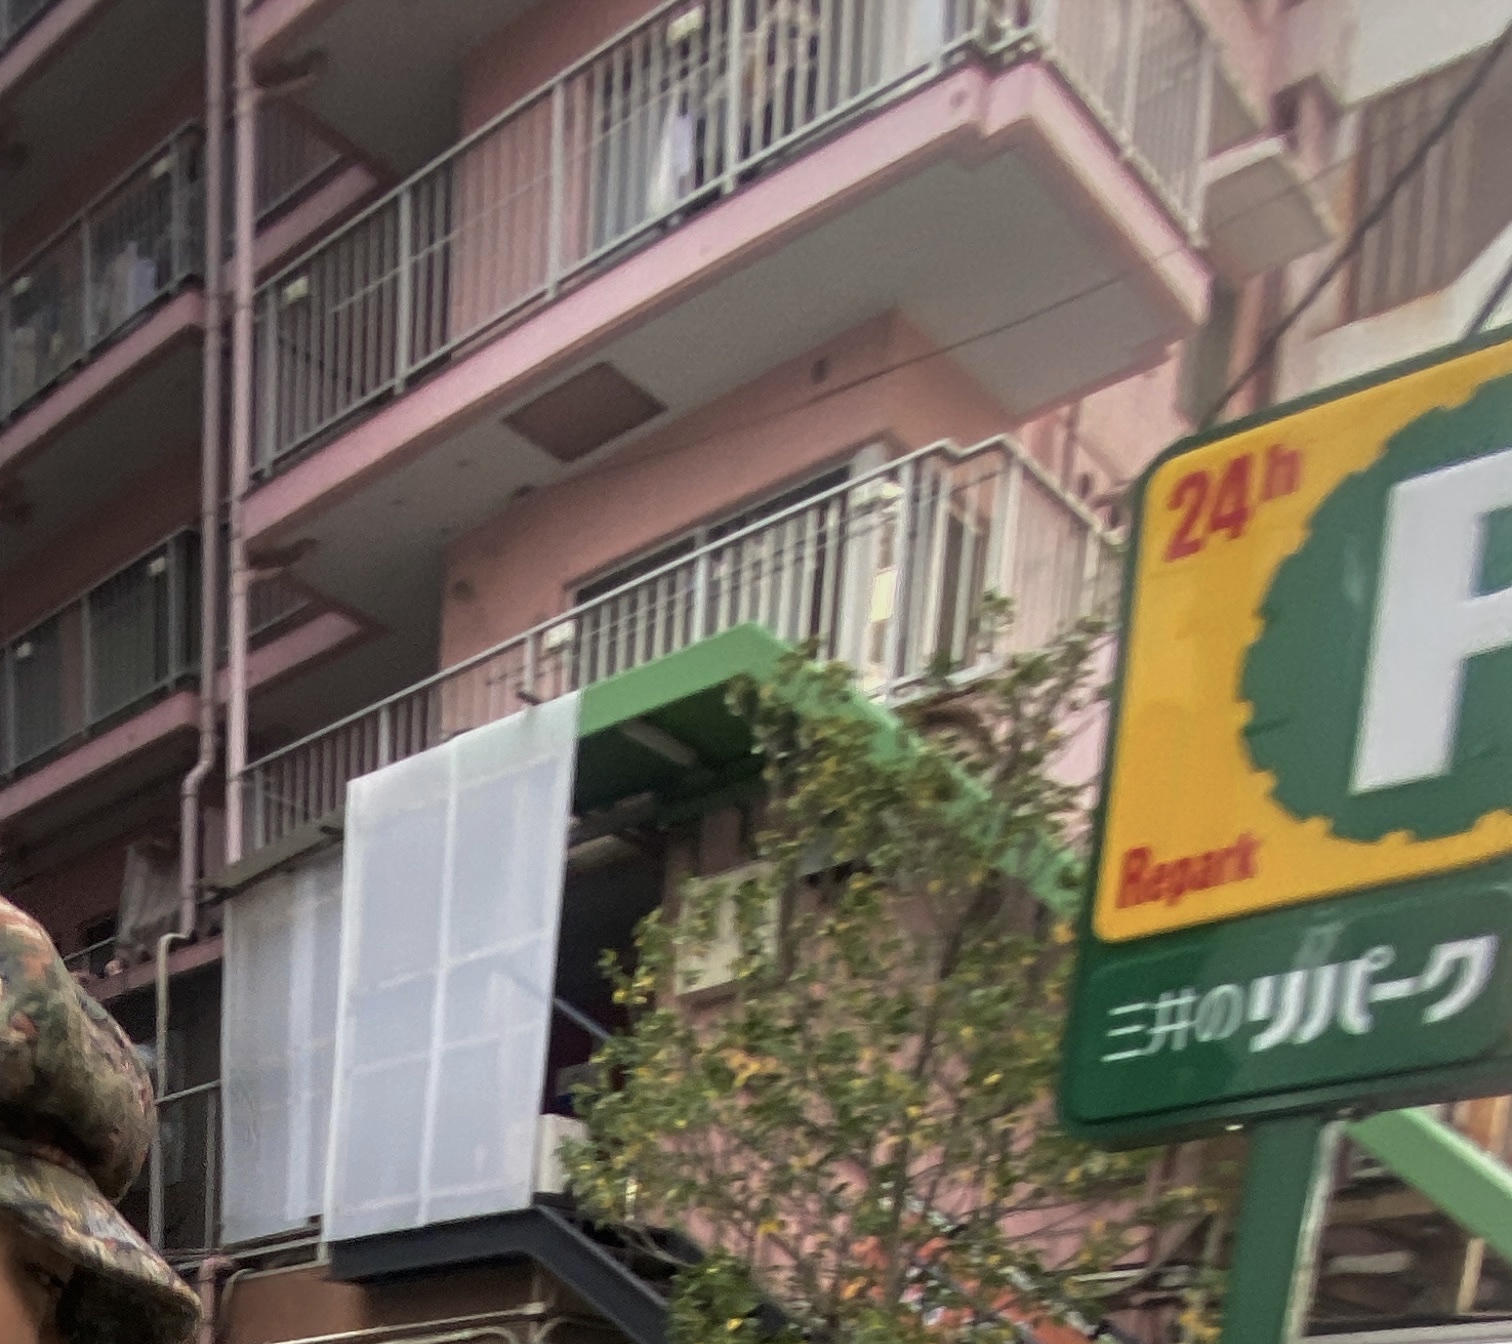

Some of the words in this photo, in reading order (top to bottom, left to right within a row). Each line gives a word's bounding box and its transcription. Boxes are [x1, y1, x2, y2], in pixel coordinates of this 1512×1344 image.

[1162, 443, 1303, 562] 24h
[1115, 831, 1260, 912] Repark
[1101, 935, 1497, 1064] 三井のリパーク
